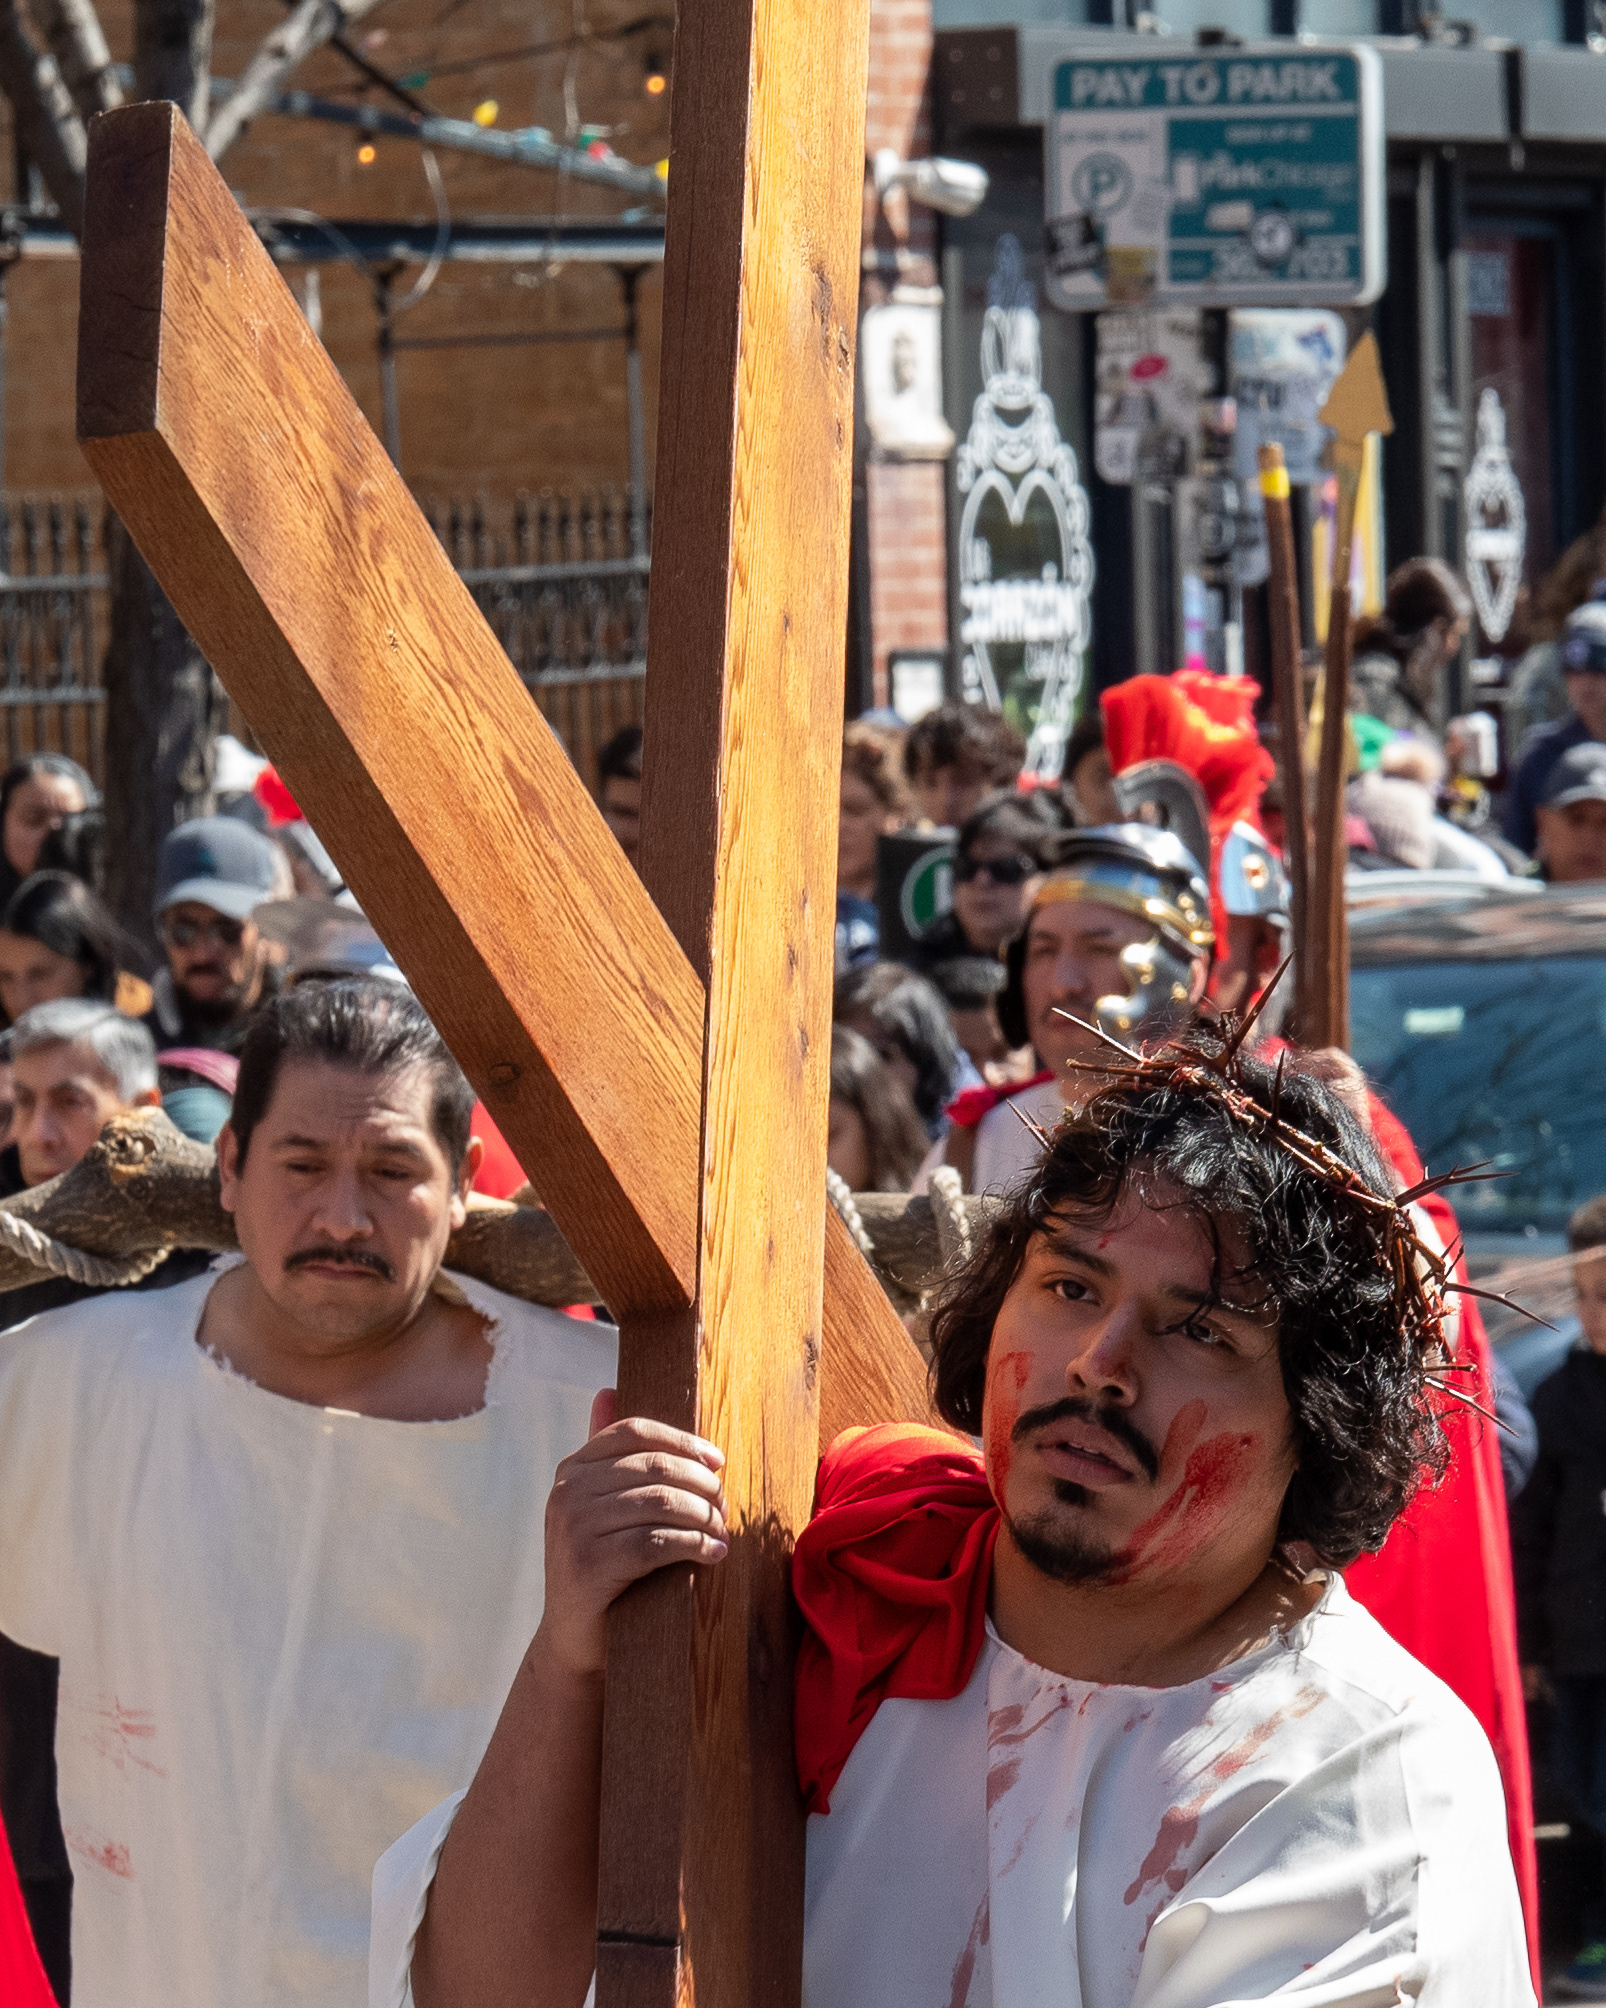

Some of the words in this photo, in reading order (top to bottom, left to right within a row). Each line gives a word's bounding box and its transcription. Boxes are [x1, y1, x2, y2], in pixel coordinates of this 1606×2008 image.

[1070, 67, 1147, 104] PAY
[1159, 62, 1221, 103] TO
[1227, 61, 1341, 101] PARK
